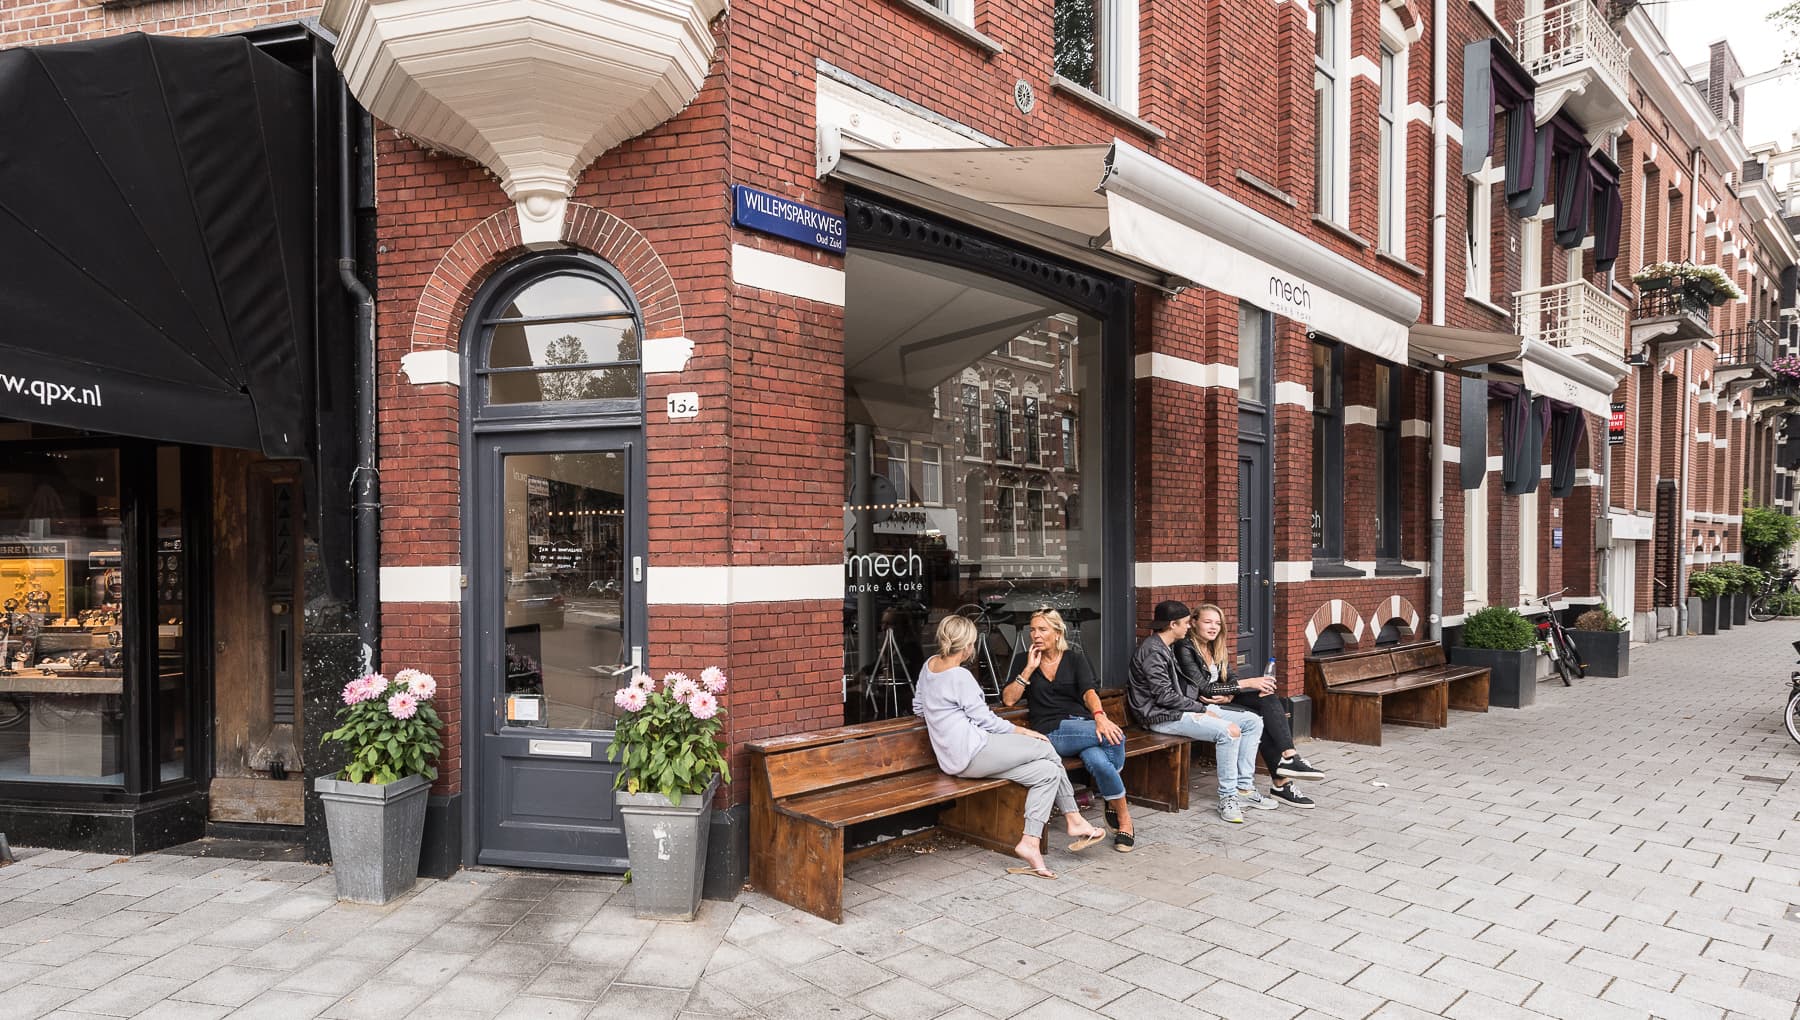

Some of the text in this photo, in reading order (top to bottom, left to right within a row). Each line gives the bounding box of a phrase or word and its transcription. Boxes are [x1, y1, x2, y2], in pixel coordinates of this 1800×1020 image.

[745, 191, 842, 235] WILLEMSPARKWEG
[816, 233, 842, 249] Oud Zuid
[1270, 277, 1311, 309] mech
[0, 374, 101, 406] w.qpx.nl
[0, 545, 58, 554] BREITLING
[849, 548, 922, 577] mech
[848, 581, 923, 593] make & take
